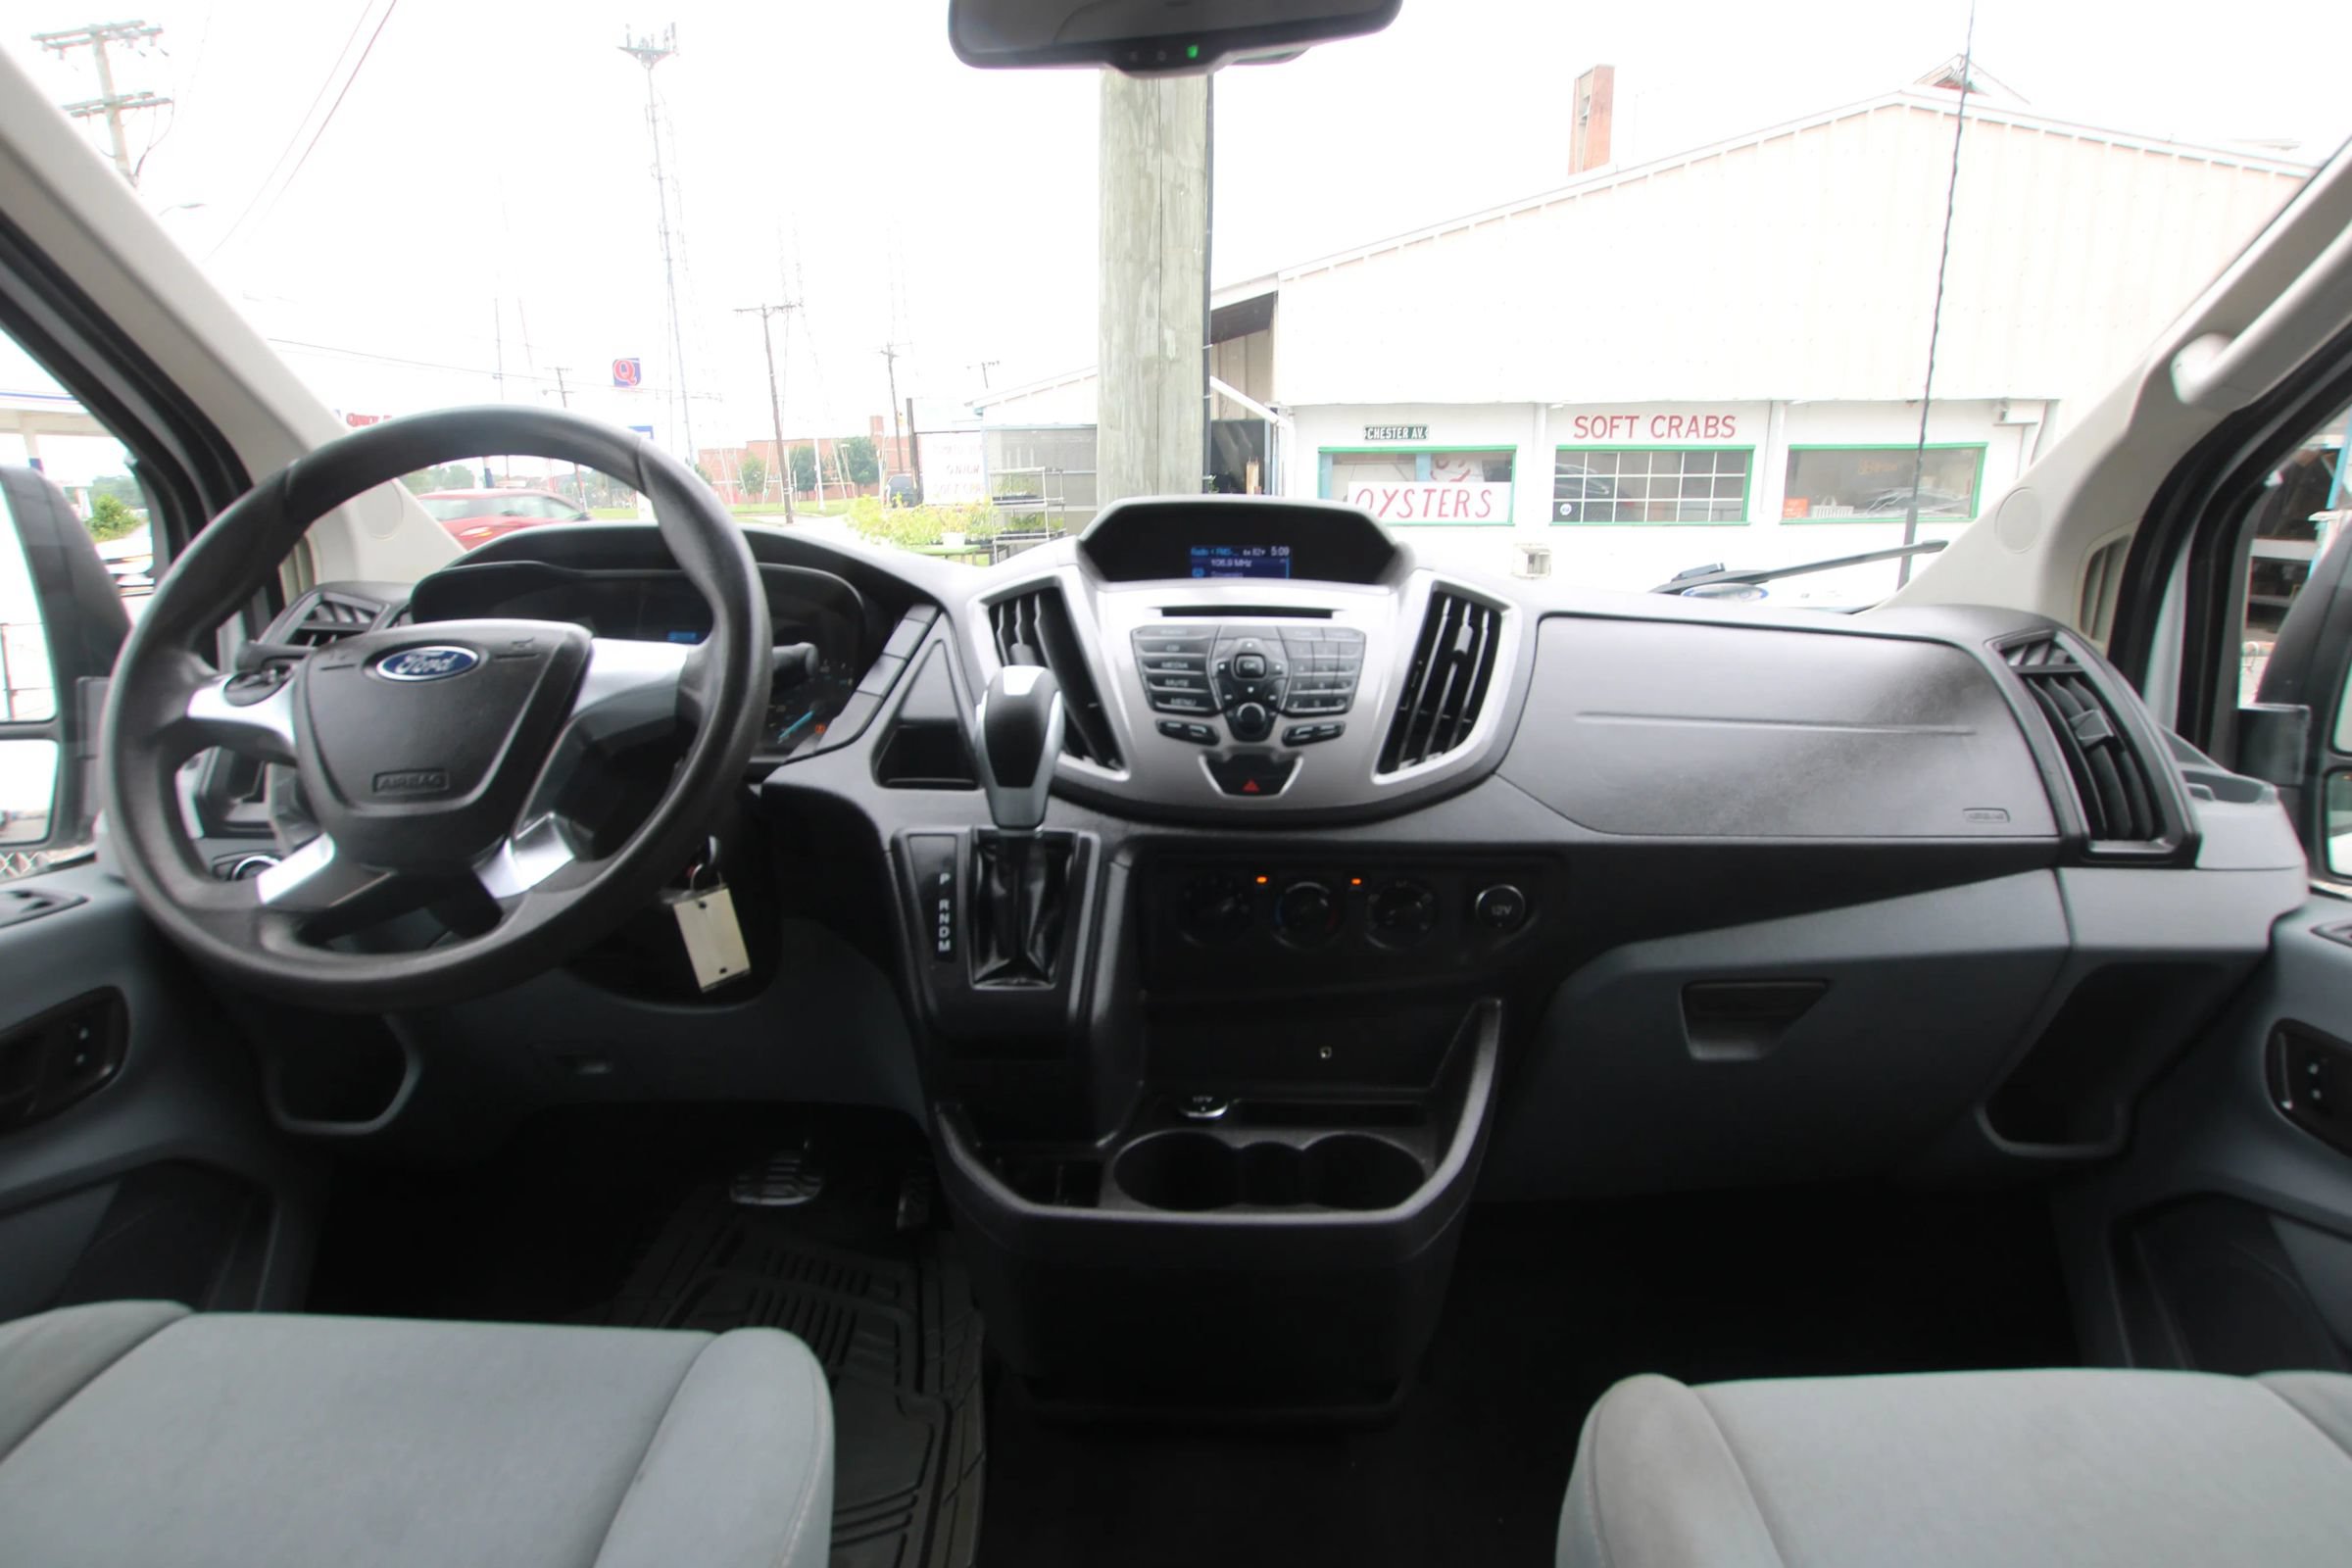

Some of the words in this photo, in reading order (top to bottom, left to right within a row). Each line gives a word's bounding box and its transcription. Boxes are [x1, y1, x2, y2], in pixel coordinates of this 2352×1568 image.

[613, 360, 637, 386] Q
[1367, 427, 1408, 439] CHESTER
[1574, 416, 1640, 439] SOFT
[1650, 416, 1737, 439] CRABS
[1355, 488, 1493, 518] OYSTERS
[1271, 546, 1290, 557] 5:09
[395, 651, 457, 675] Ford
[1170, 698, 1198, 707] MENU
[376, 774, 443, 792] AIRBAG
[939, 873, 951, 886] P
[939, 900, 951, 911] R
[939, 913, 951, 925] N
[938, 941, 951, 953] M
